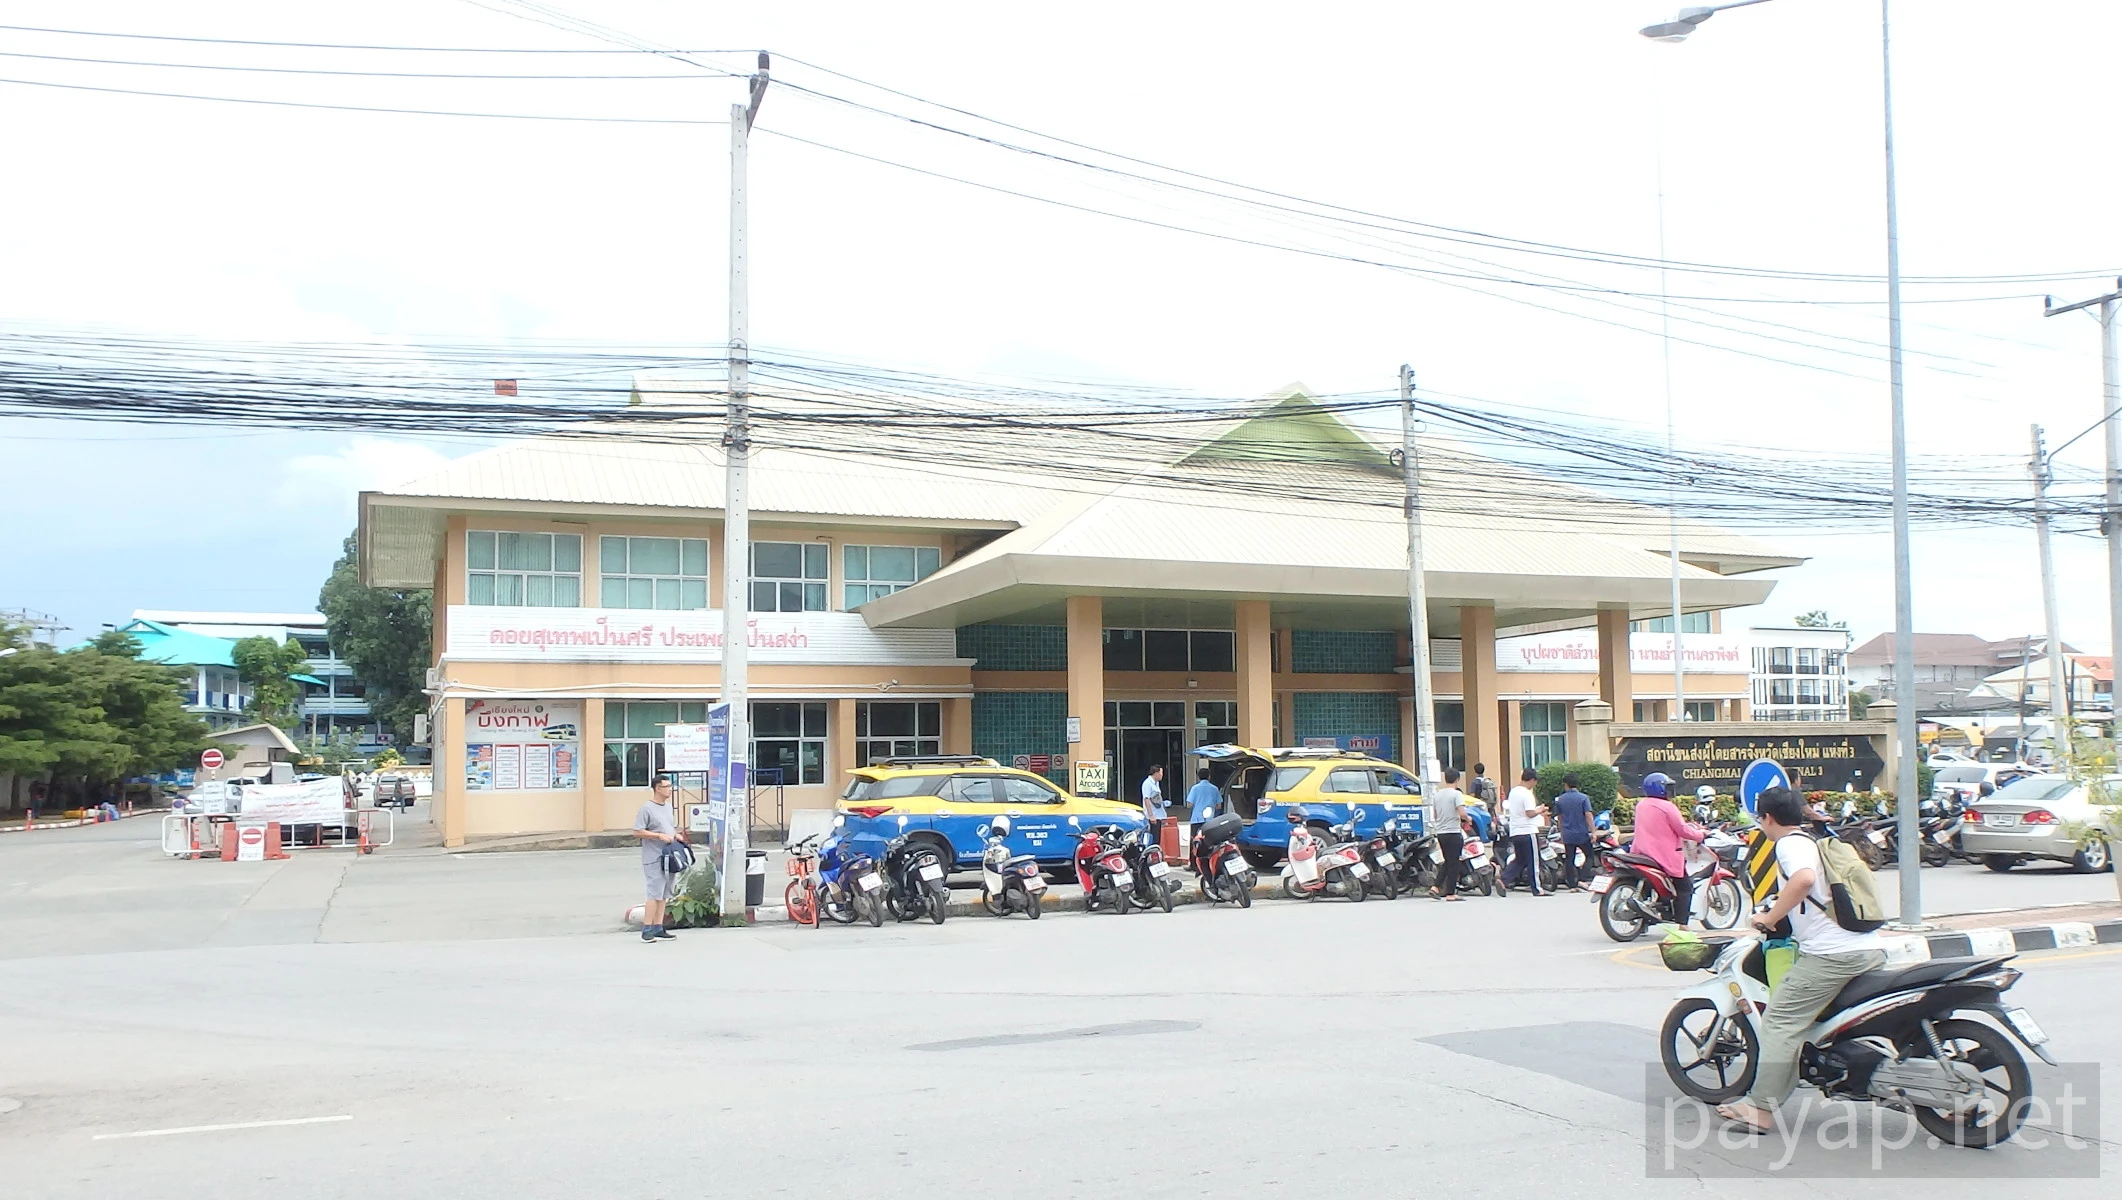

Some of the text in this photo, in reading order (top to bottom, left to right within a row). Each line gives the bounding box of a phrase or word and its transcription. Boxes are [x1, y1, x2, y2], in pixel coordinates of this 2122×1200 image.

[489, 616, 653, 652] ดอยสุเทพเป็นศรี
[491, 705, 530, 714] เชียงใหม่
[1646, 738, 1820, 767] สถานีขนส่งผู้โดยสารจังหวัดเชียงใหม่
[1079, 768, 1105, 779] TAXI
[1682, 767, 1741, 779] CHIANGMAI
[1818, 766, 1823, 776] 3
[1079, 780, 1105, 788] Arcade
